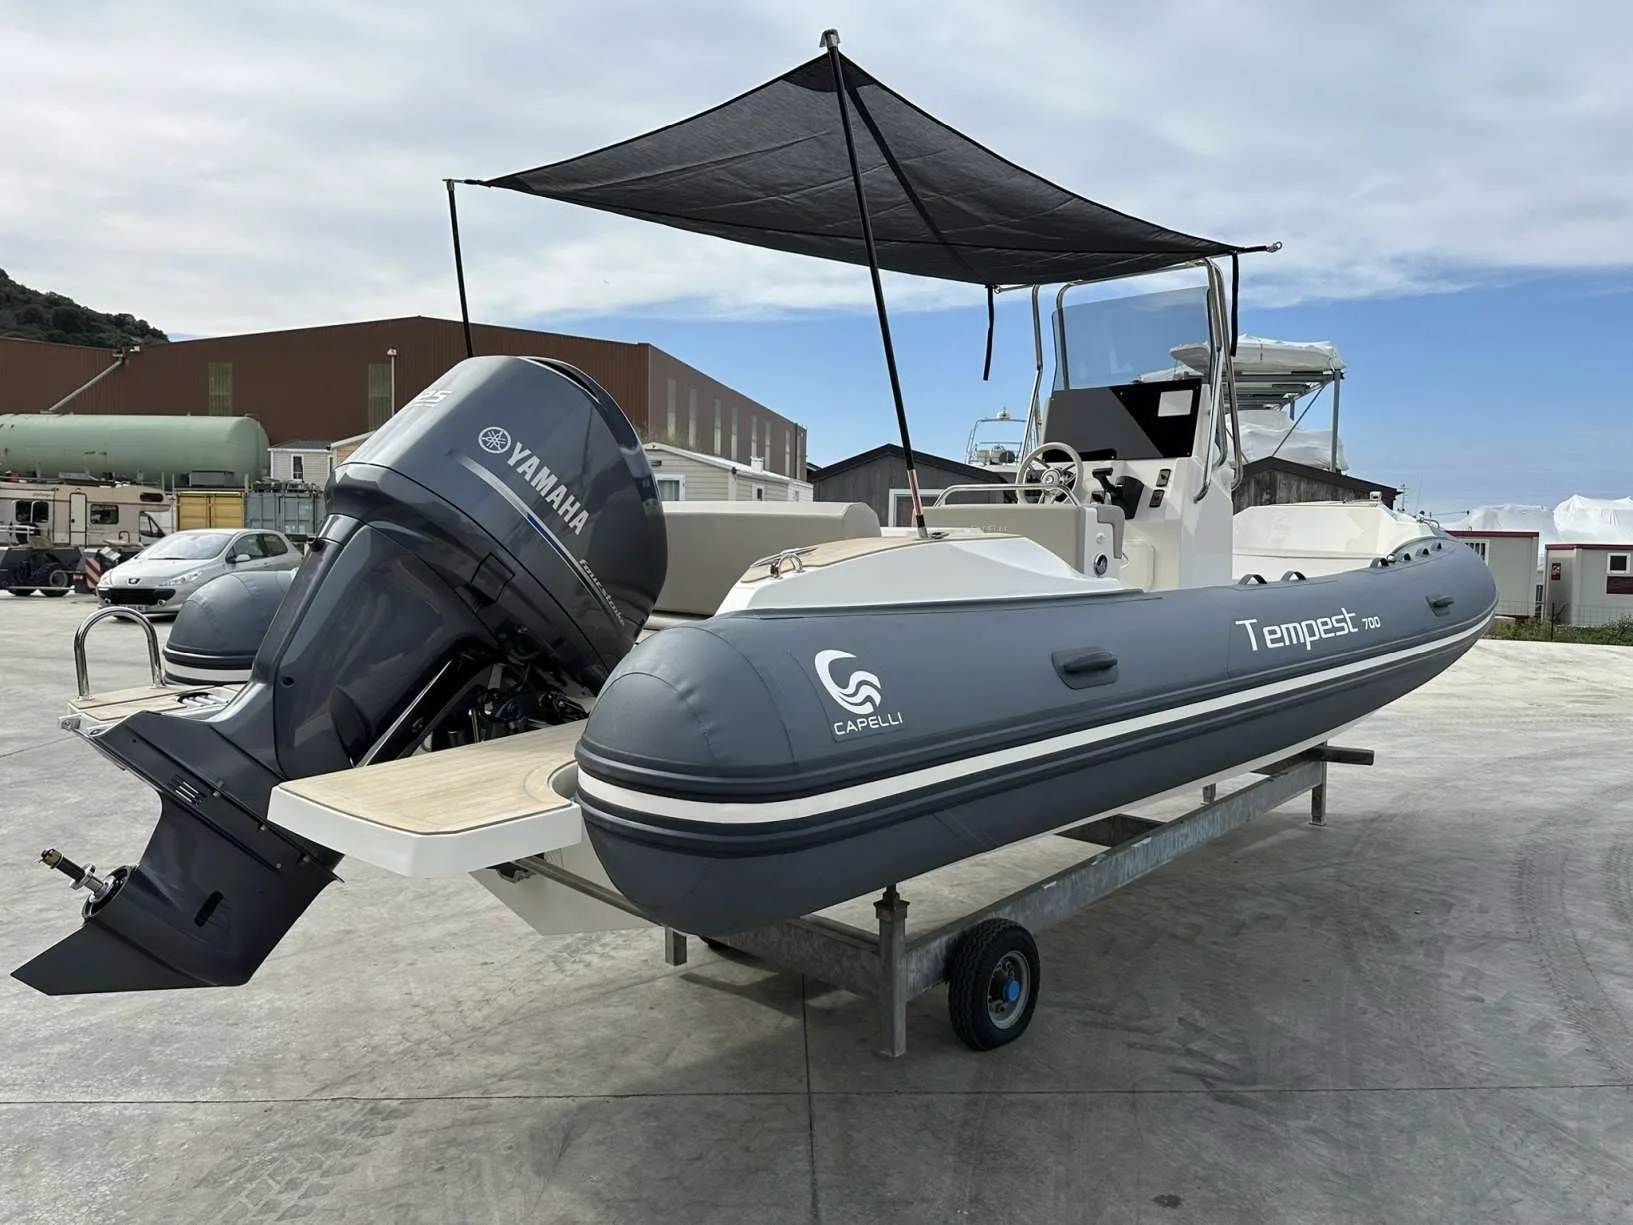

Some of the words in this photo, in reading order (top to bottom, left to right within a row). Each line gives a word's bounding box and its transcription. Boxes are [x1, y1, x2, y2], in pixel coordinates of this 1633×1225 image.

[506, 442, 590, 536] YAMAHA
[1235, 607, 1358, 651] Tempest
[1361, 616, 1381, 631] 700
[833, 711, 903, 735] CAPELLI
